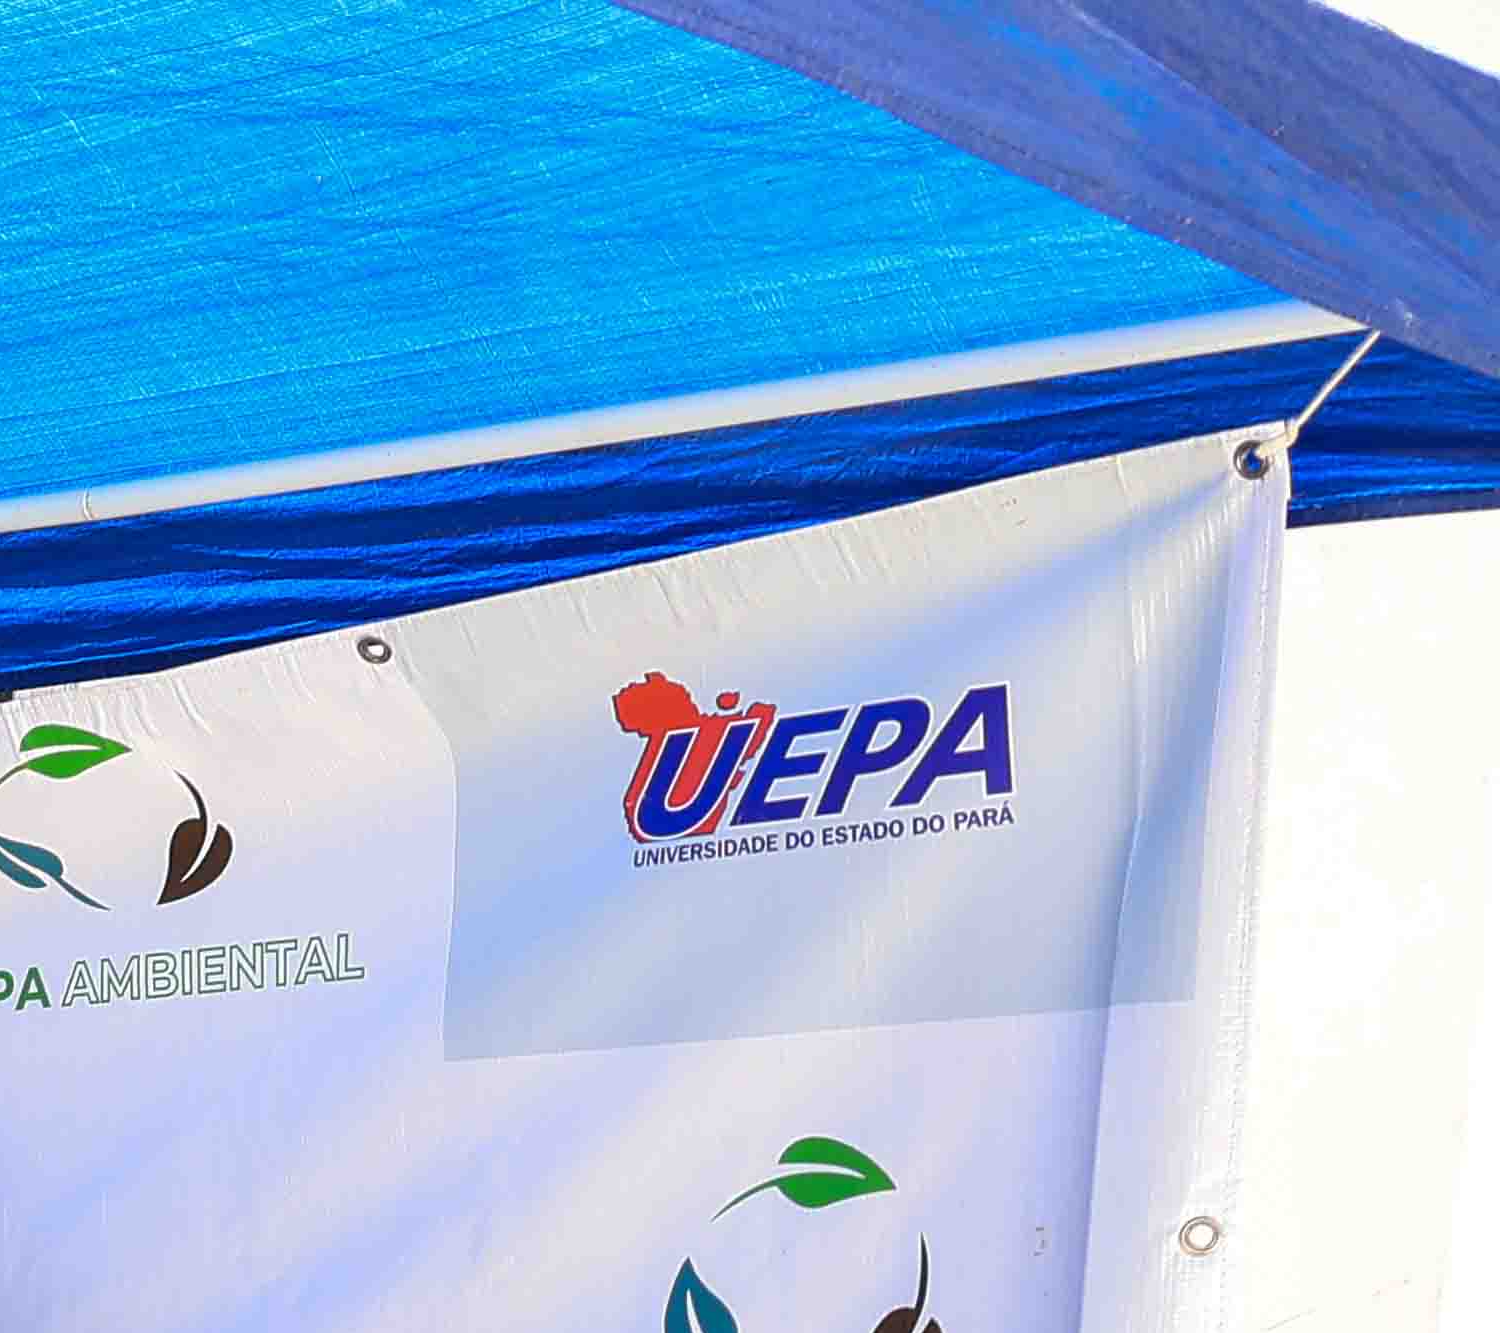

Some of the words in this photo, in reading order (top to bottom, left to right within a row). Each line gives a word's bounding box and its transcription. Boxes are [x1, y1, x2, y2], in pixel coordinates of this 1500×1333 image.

[634, 680, 1016, 840] UEPA
[633, 834, 779, 868] UNIVERSIDADE
[785, 828, 815, 850] DO
[821, 818, 906, 847] ESTADO
[912, 814, 946, 836] DO
[953, 800, 1016, 832] PARÁ
[60, 932, 365, 1009] AMBIENTAL
